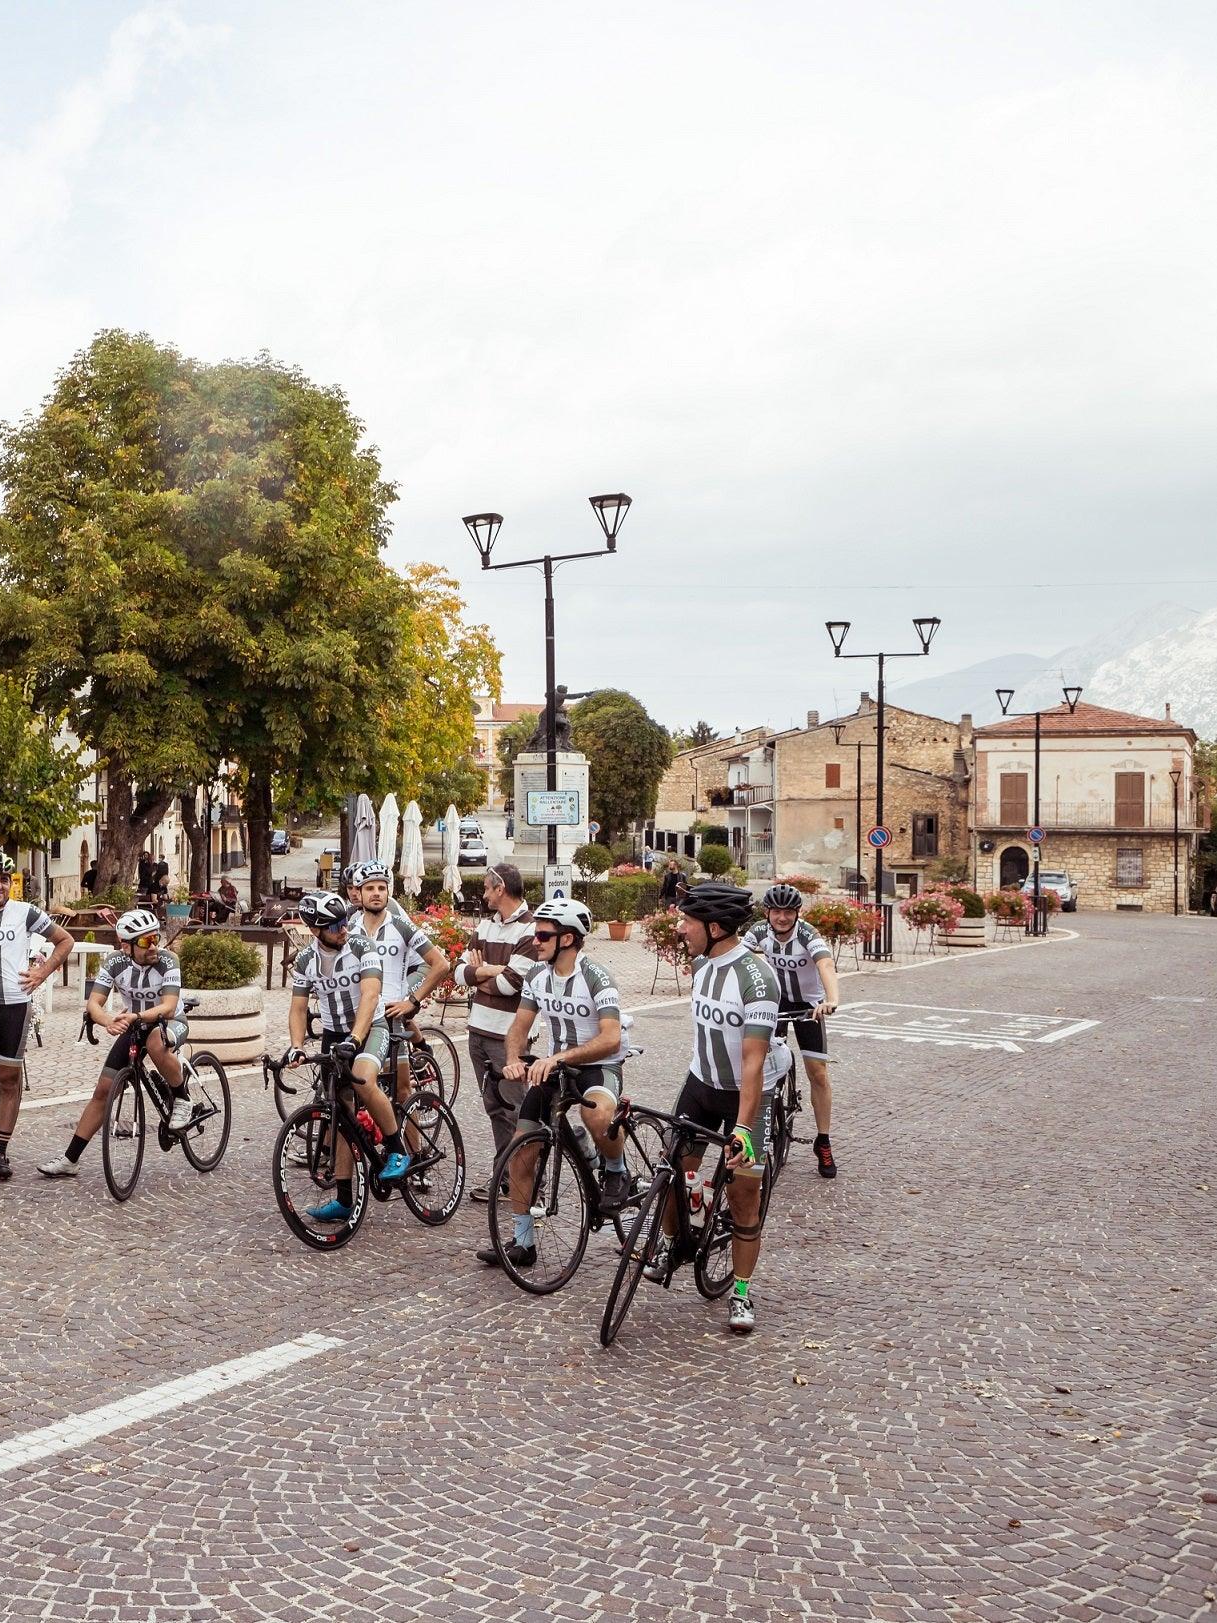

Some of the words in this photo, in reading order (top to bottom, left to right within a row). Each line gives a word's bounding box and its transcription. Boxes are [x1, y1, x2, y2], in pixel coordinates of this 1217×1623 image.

[588, 963, 611, 987] enecta
[746, 963, 767, 998] enecta
[762, 1106, 773, 1152] enecta
[348, 1161, 365, 1230] EASTON
[442, 1165, 465, 1217] EASTON
